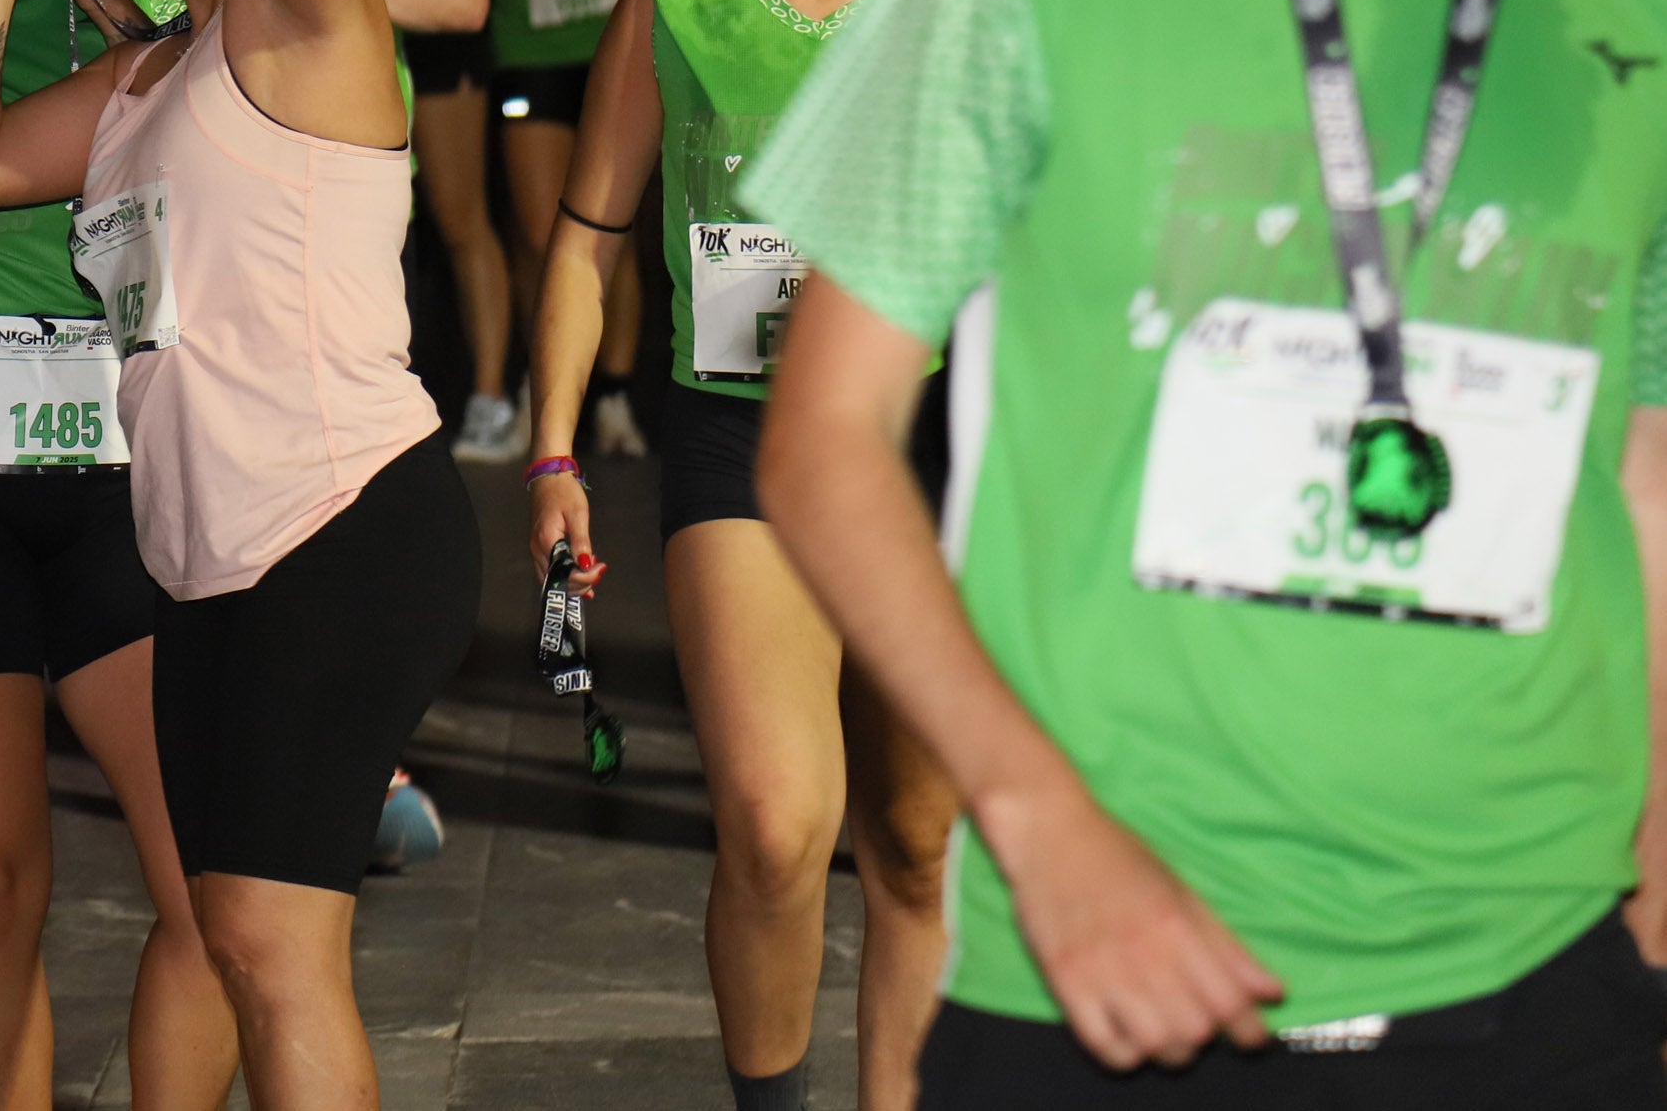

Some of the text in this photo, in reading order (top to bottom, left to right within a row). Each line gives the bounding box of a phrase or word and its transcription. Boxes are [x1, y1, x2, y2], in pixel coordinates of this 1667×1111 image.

[155, 198, 163, 222] 4
[698, 226, 731, 256] 10K
[778, 278, 805, 299] AR
[66, 324, 90, 333] Binter
[87, 337, 112, 346] VASCO
[9, 402, 103, 449] 1485
[540, 589, 566, 653] FINISHER
